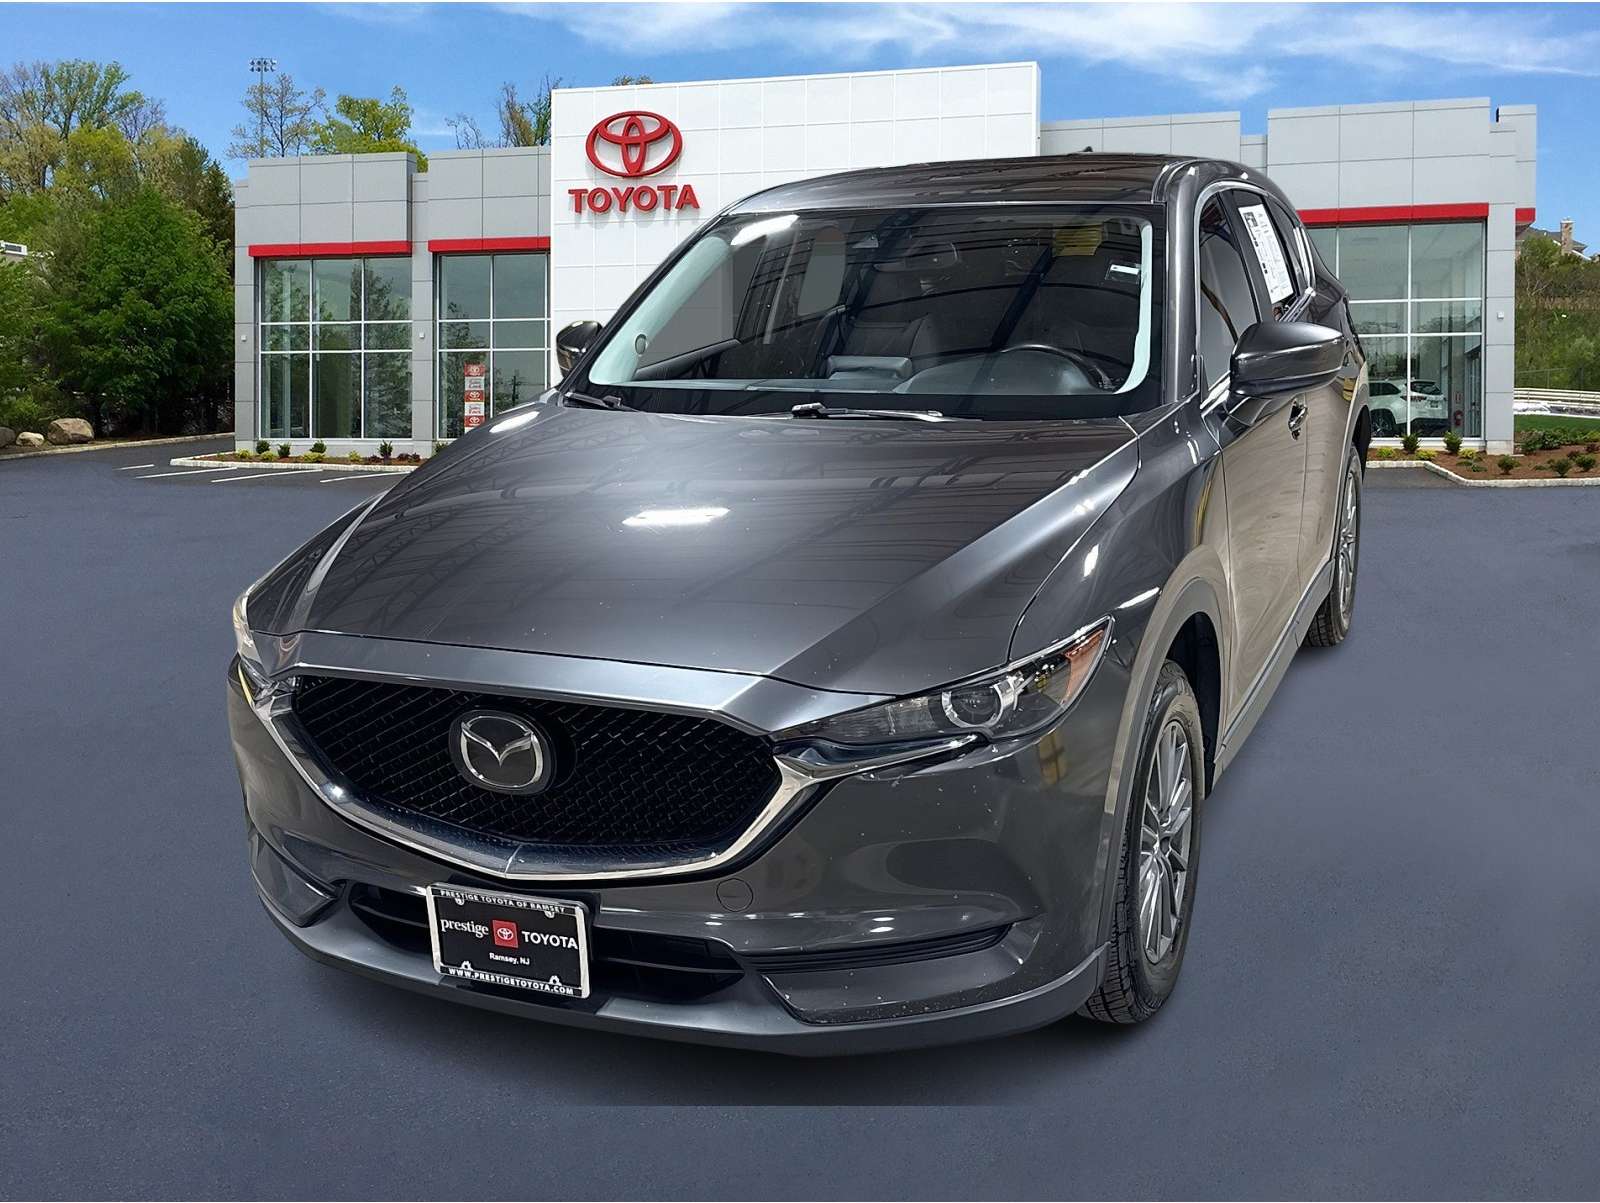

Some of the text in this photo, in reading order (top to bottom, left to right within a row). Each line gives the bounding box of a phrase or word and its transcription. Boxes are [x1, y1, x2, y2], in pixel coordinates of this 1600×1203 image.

[568, 184, 700, 214] TOYOTA
[440, 890, 480, 901] PRESTIGE
[481, 895, 514, 907] TOYOTA
[530, 903, 565, 913] RAMSEY
[440, 919, 489, 938] prestige
[521, 930, 578, 950] TOYOTA
[489, 952, 530, 965] Ramsey, NJ
[448, 967, 574, 995] WWW.PRESTIGETOYOTA.COM
